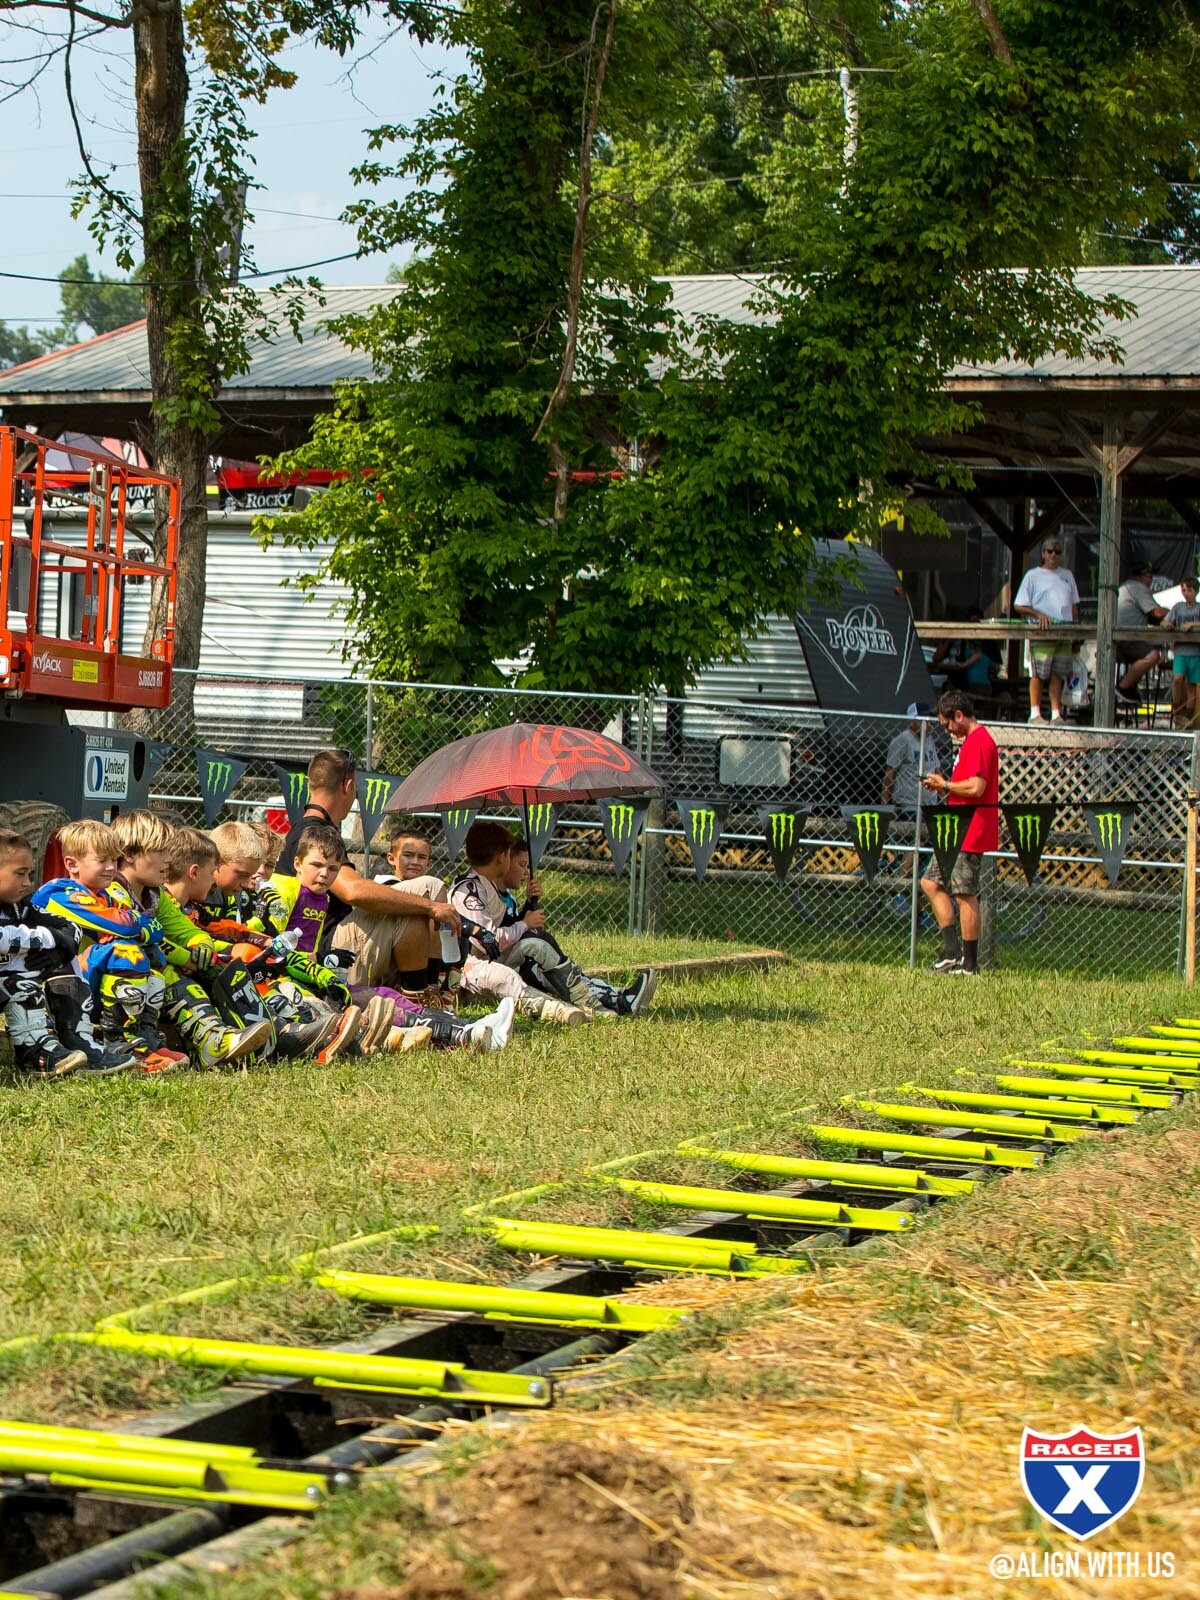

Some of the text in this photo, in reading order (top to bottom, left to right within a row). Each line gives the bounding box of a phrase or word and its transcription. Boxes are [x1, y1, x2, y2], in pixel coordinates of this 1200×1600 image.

[245, 493, 292, 509] ROCKY
[32, 650, 62, 673] KYJACK
[104, 757, 127, 775] United
[102, 775, 126, 793] Rentals
